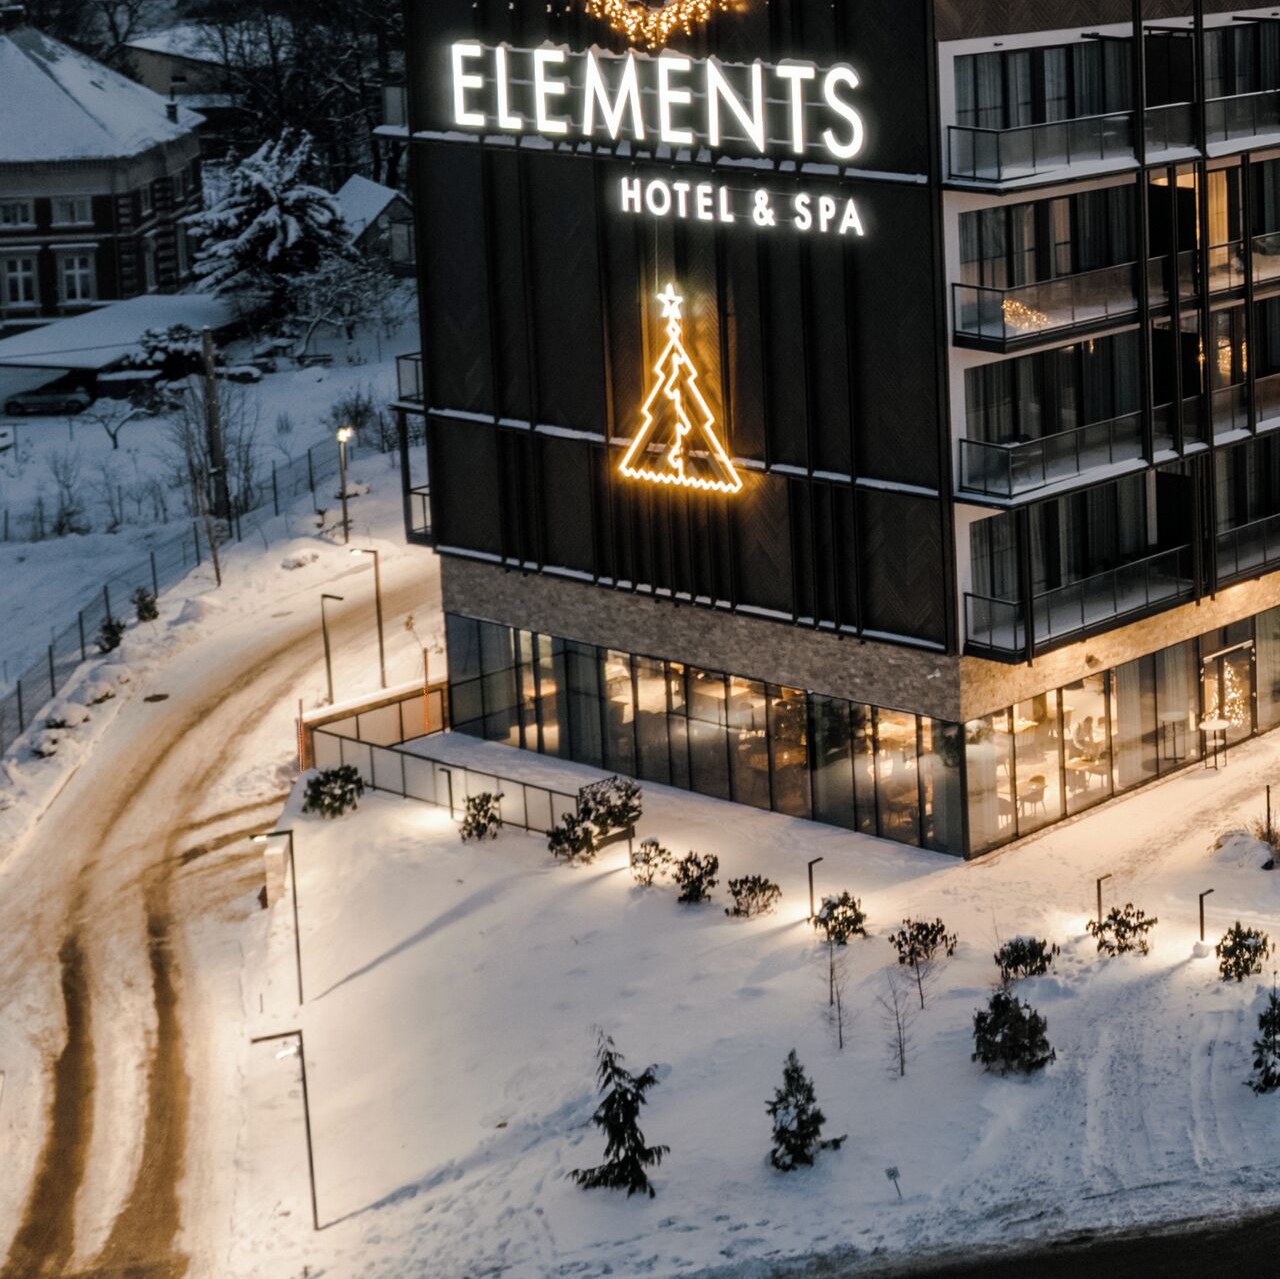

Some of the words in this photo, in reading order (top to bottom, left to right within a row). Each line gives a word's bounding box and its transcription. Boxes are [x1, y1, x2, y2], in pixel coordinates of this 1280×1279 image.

[452, 43, 866, 159] ELEMENTS
[621, 177, 735, 222] HOTEL
[753, 189, 776, 226] &
[794, 193, 864, 236] SPA
